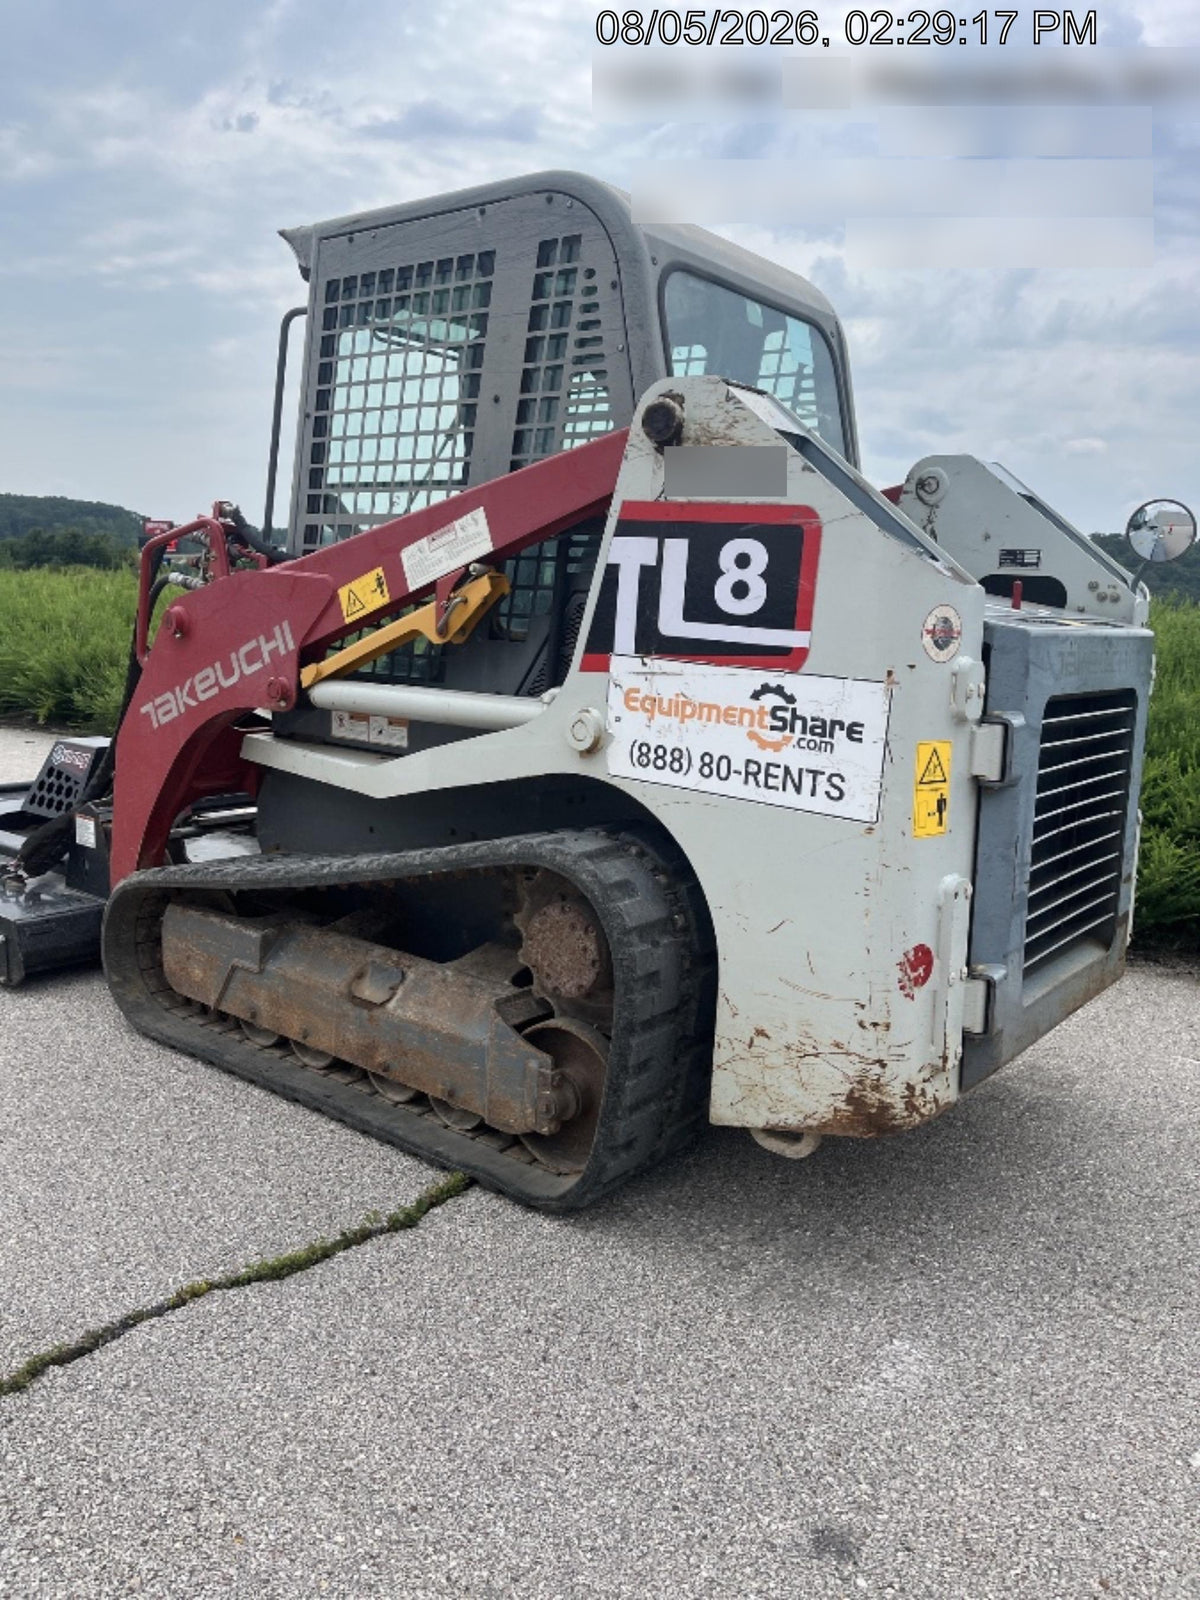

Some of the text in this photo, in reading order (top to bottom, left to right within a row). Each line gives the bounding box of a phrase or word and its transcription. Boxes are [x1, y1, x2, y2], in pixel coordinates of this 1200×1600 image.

[606, 536, 811, 656] TL8
[623, 687, 865, 743] EquipmentShare
[629, 739, 846, 802] (888) 80-RENTS
[792, 737, 835, 755] .com
